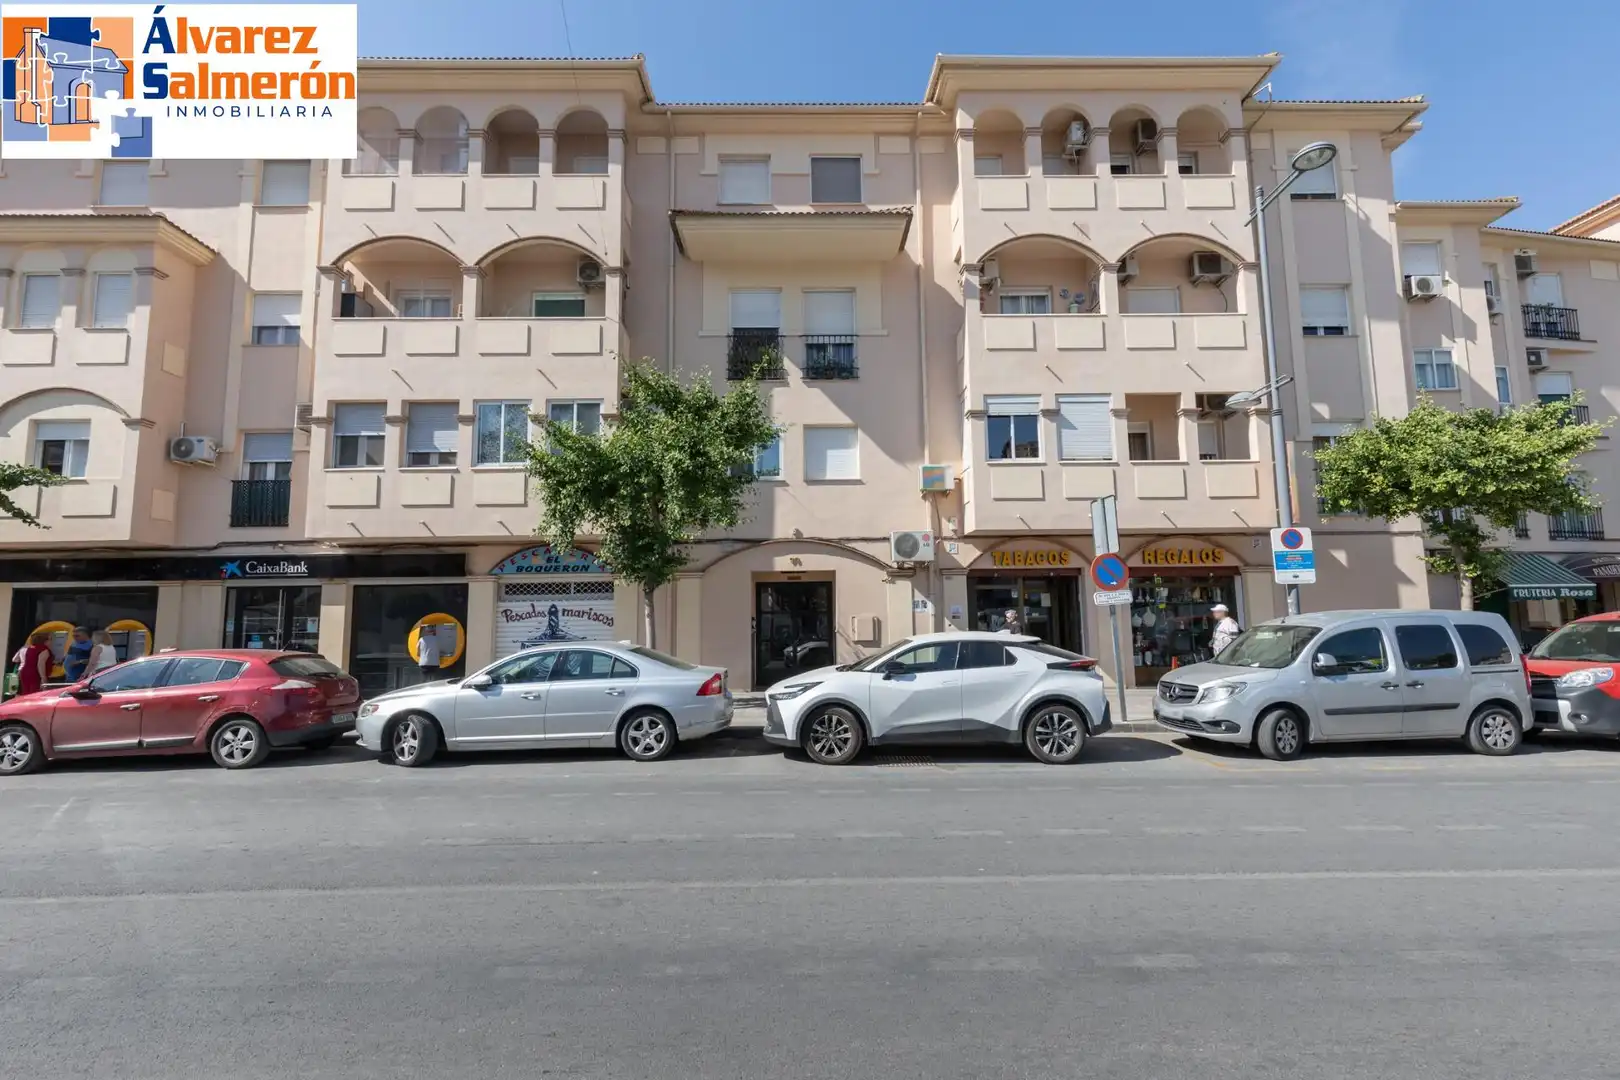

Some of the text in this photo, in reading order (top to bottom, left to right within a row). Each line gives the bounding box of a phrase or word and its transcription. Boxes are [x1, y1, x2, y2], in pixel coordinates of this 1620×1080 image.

[545, 555, 561, 564] EL
[992, 550, 1071, 567] TABACOS
[1142, 548, 1225, 565] REGALOS
[245, 560, 309, 574] CaixaBank
[515, 564, 590, 573] BOQUERON
[1513, 588, 1594, 598] FRUTERIA Rosa
[501, 602, 615, 627] Pescados mariscos
